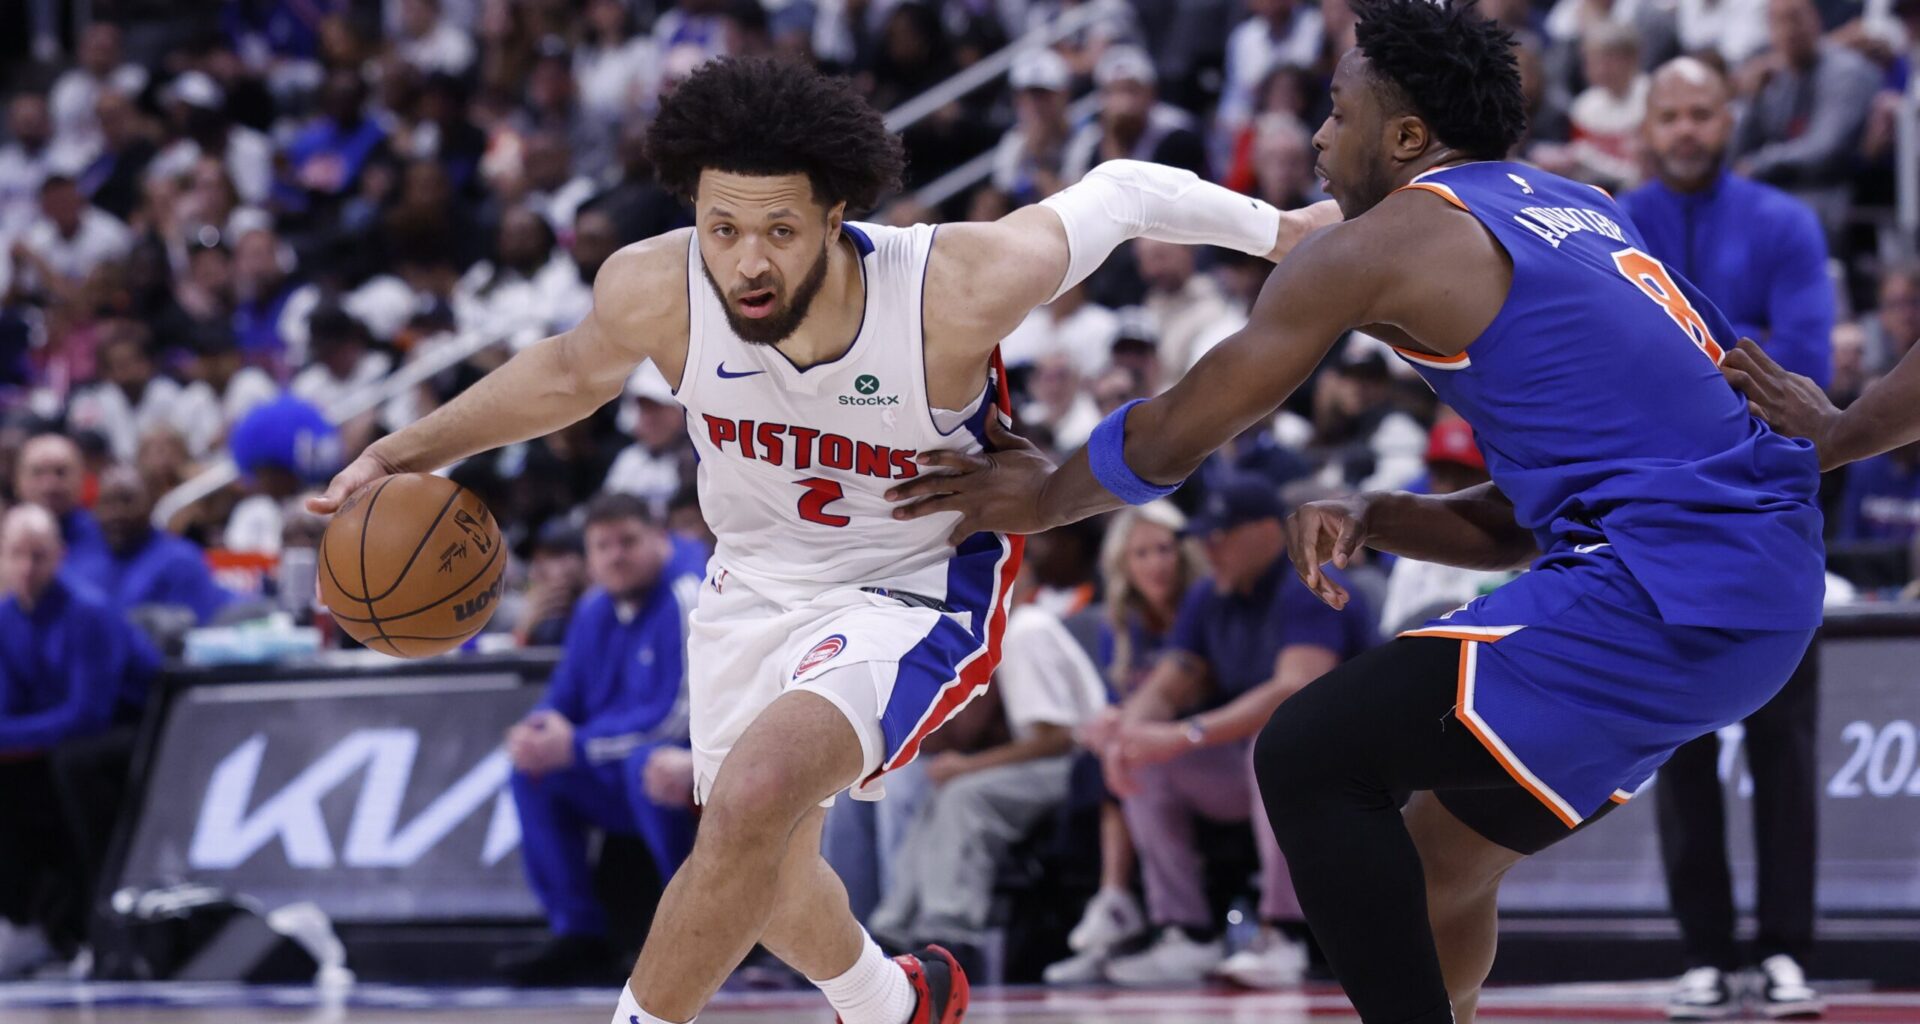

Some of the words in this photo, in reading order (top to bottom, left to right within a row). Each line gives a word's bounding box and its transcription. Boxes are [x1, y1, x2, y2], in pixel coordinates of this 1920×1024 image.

[1610, 247, 1726, 367] 8
[838, 394, 900, 406] StockX
[701, 413, 919, 480] PISTONS
[791, 476, 851, 528] 2
[1826, 719, 1920, 798] 20
